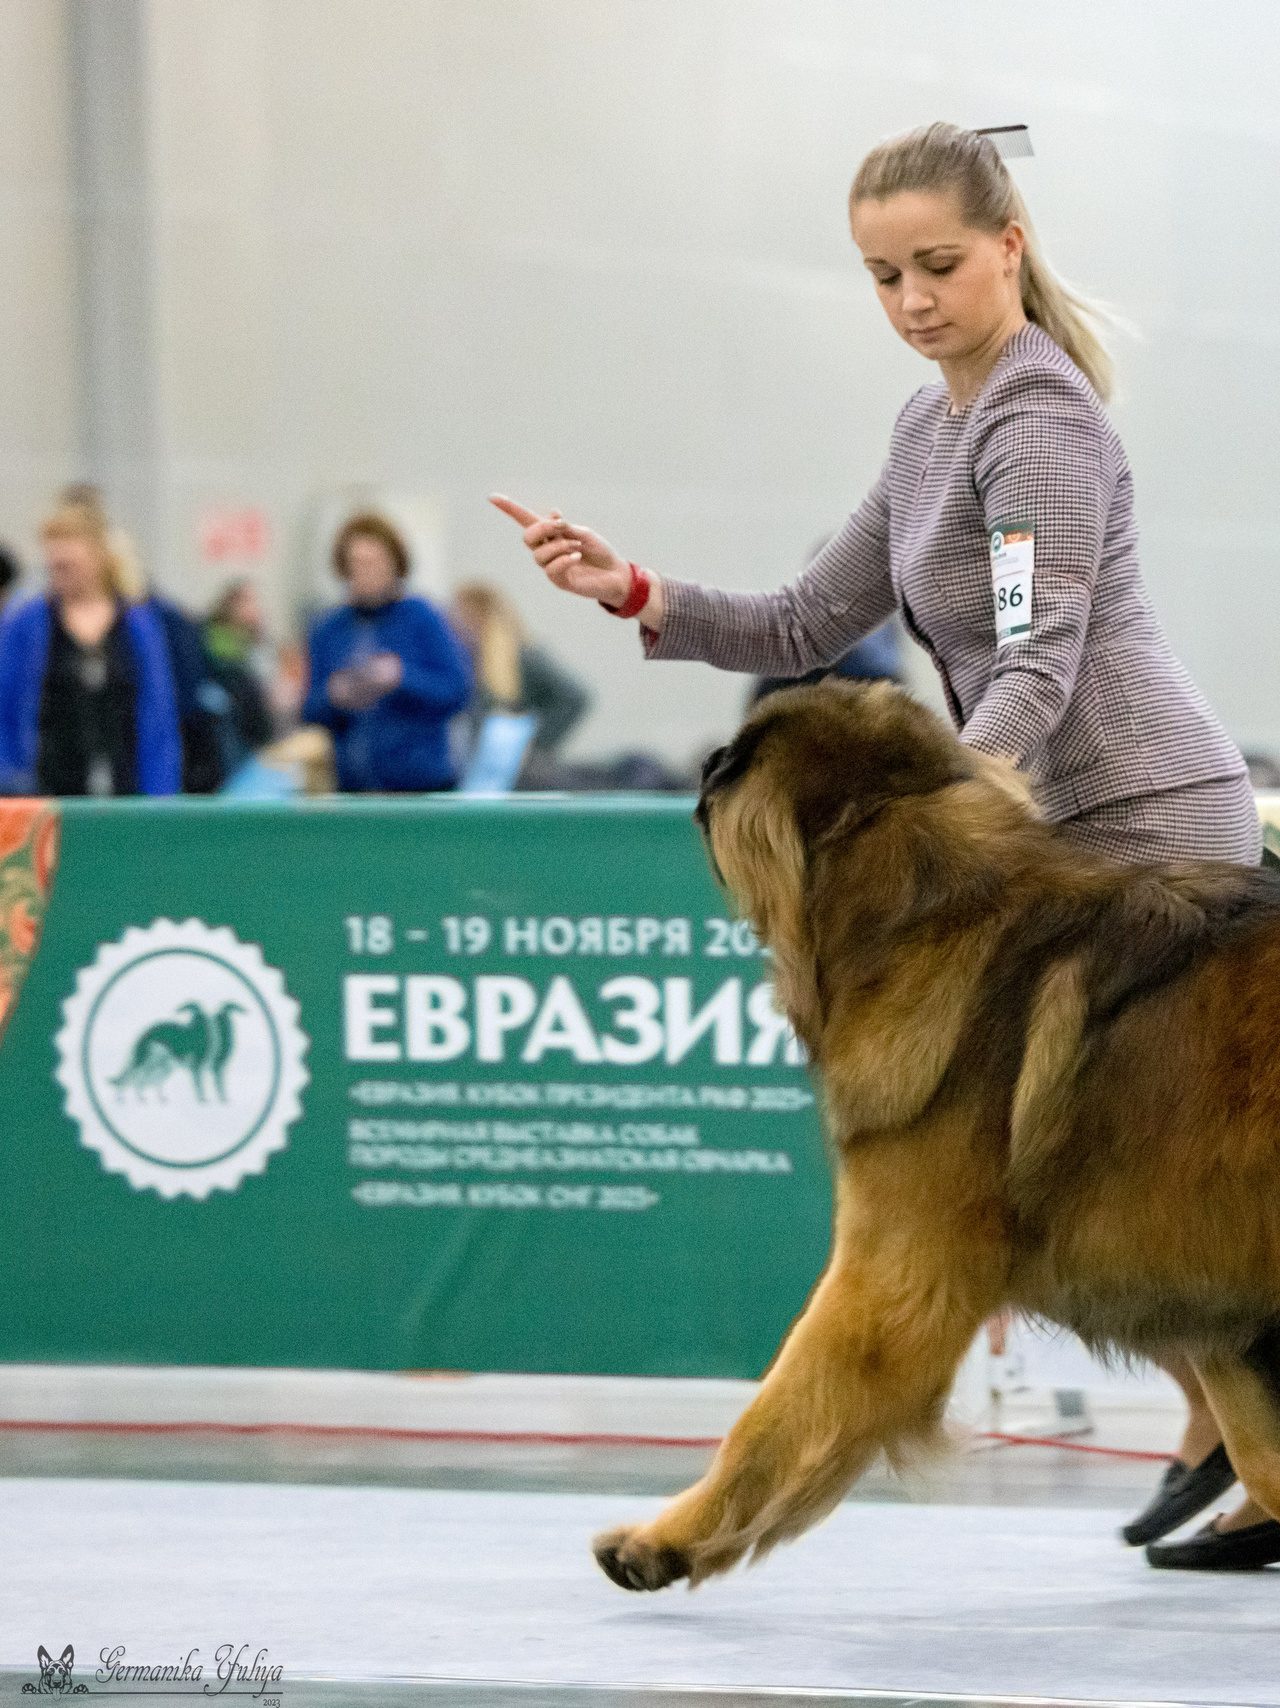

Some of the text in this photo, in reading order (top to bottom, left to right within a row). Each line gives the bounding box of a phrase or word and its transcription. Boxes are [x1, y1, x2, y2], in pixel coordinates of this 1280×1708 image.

[998, 583, 1023, 611] 86
[345, 915, 394, 954] 18
[442, 916, 491, 955] 19
[506, 916, 692, 956] НОЯБРЯ
[344, 973, 810, 1065] ЕВРАЗИЯ
